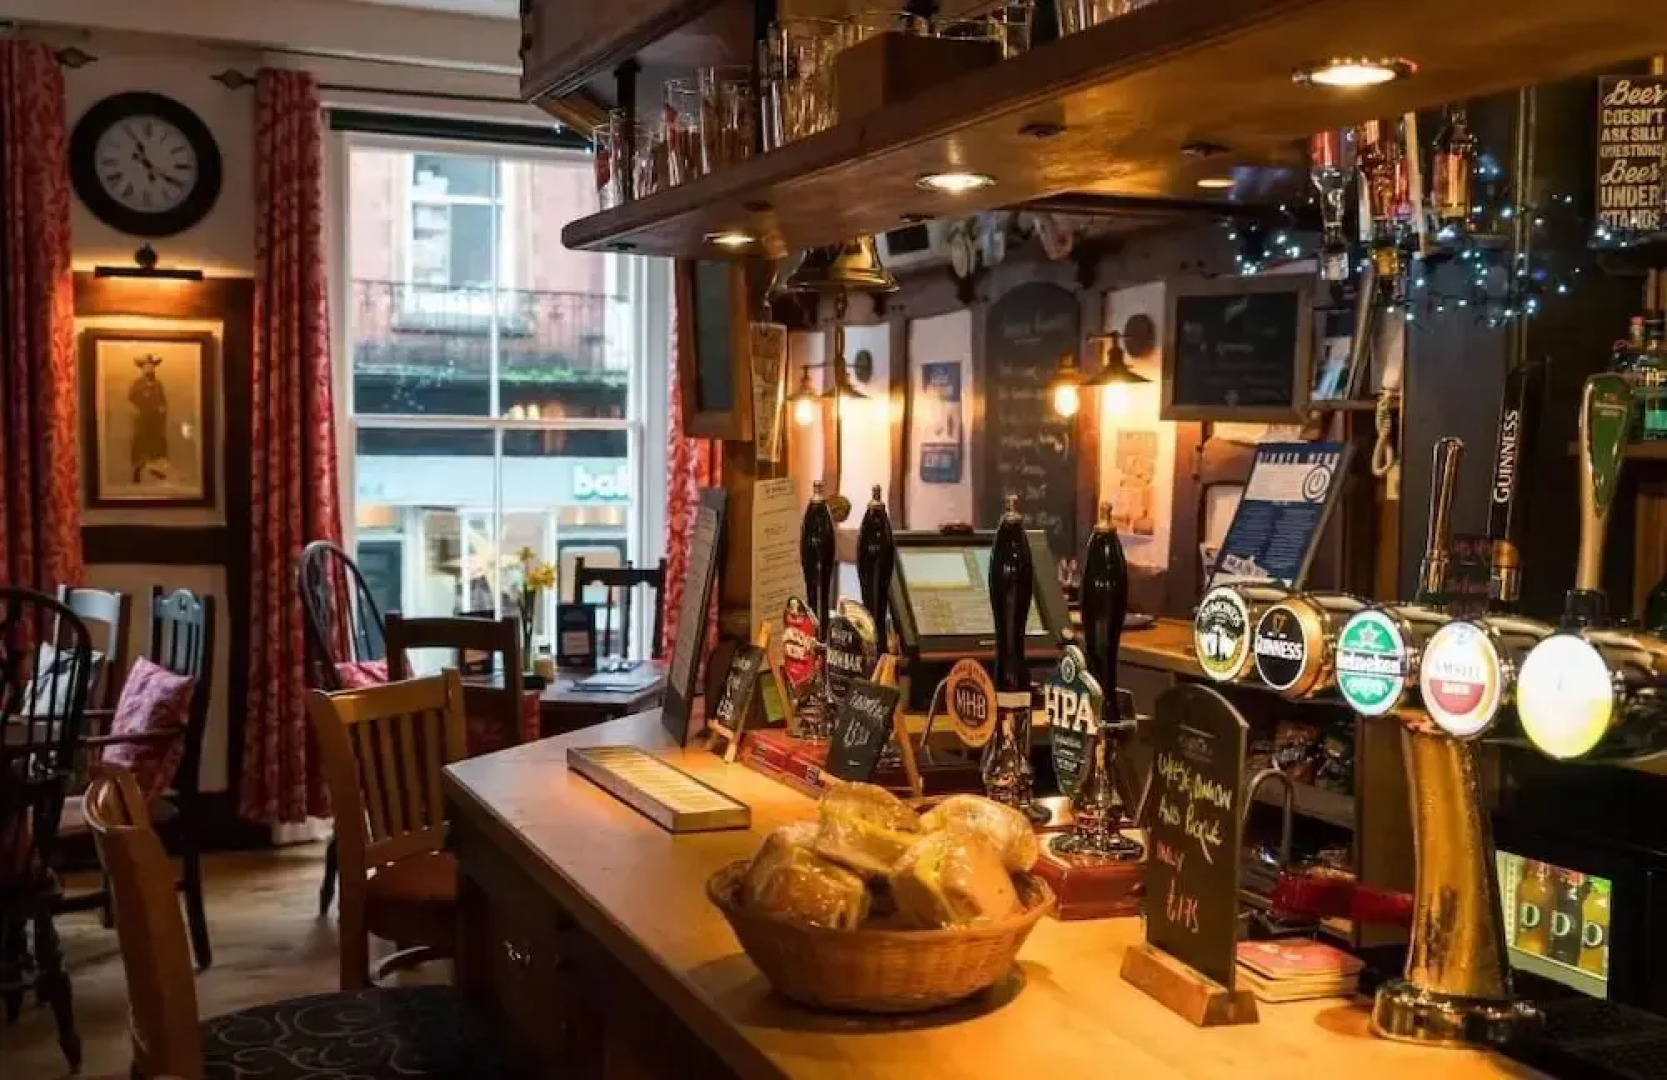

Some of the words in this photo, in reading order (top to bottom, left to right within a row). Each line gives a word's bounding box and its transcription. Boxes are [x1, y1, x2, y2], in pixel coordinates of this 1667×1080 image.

[1602, 80, 1665, 106] Beer
[1601, 127, 1629, 142] ASK
[1600, 158, 1660, 184] Beer
[1601, 184, 1660, 208] UNDER
[1493, 409, 1519, 504] GUINNESS
[1257, 634, 1303, 661] GUINNESS
[956, 688, 986, 720] MHB
[1044, 684, 1098, 735] HPA
